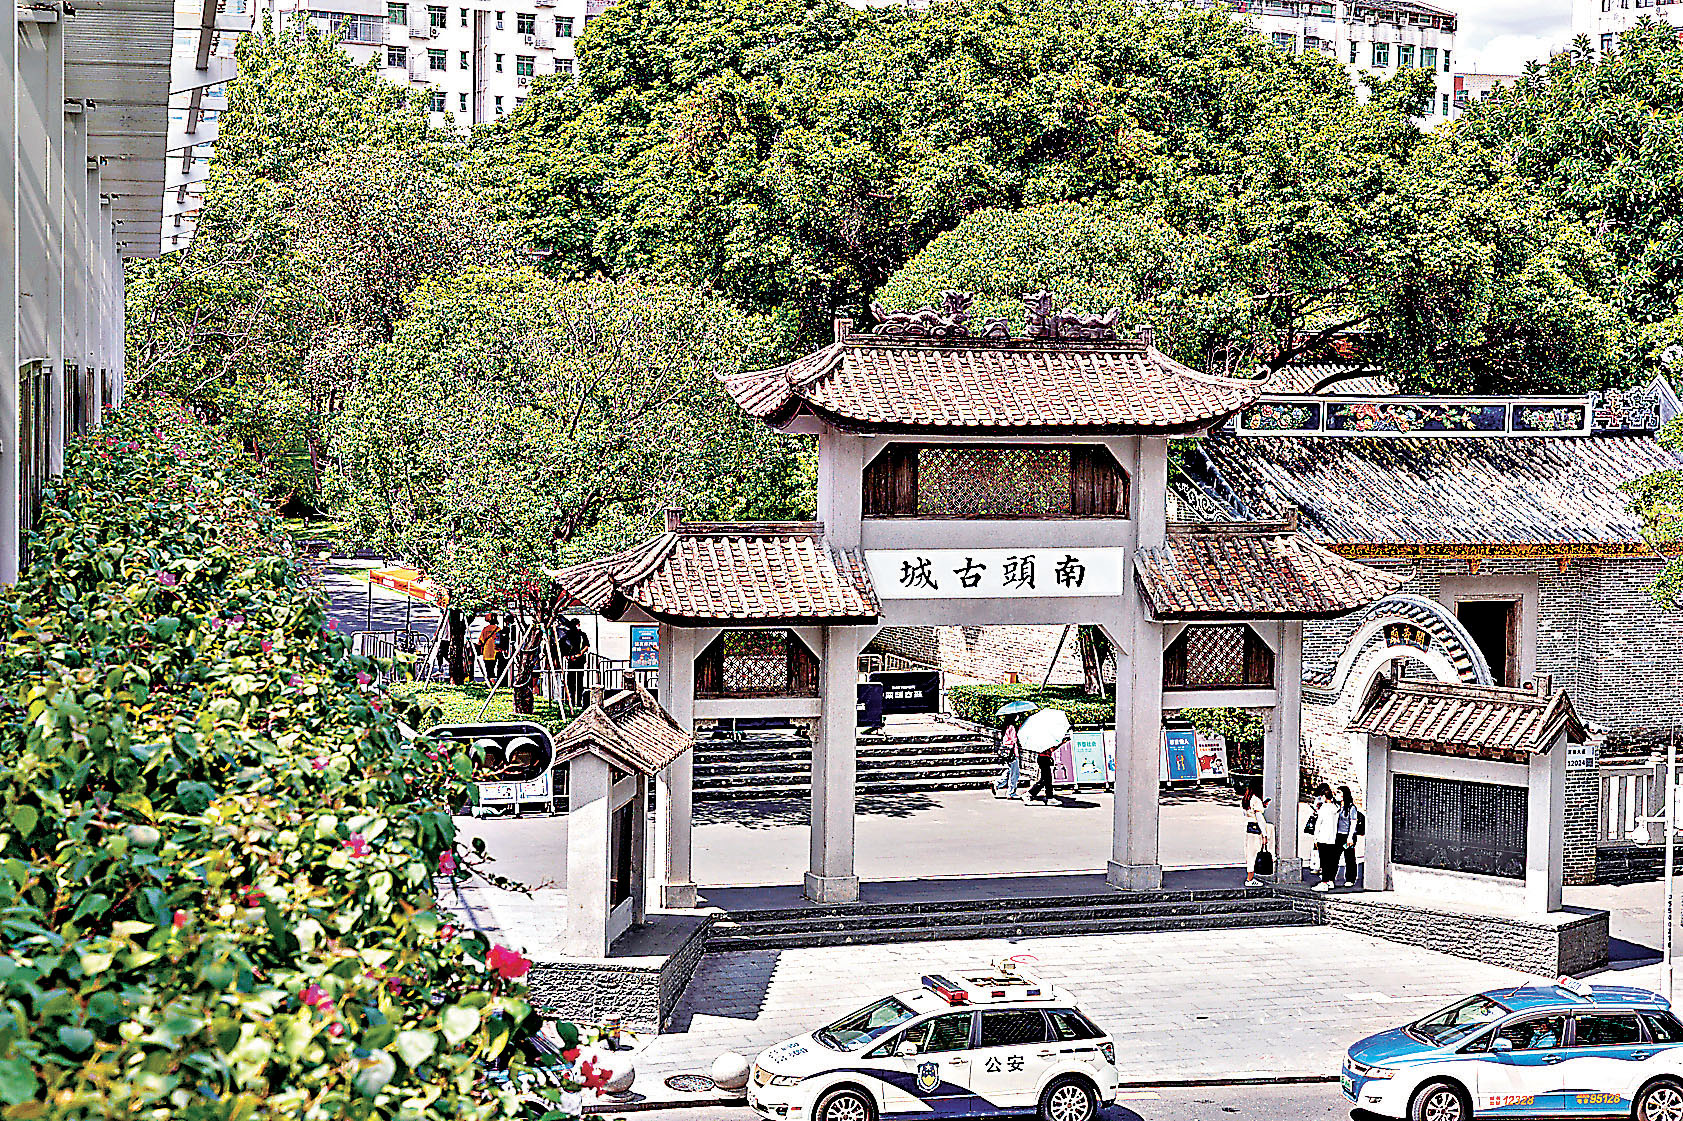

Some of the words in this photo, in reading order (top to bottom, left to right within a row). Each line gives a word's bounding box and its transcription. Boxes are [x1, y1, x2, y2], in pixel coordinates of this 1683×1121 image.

[899, 554, 1086, 590] 南頭古城
[984, 1054, 1025, 1073] 公安
[1503, 1095, 1535, 1106] 12328
[1589, 1093, 1621, 1104] 95128
